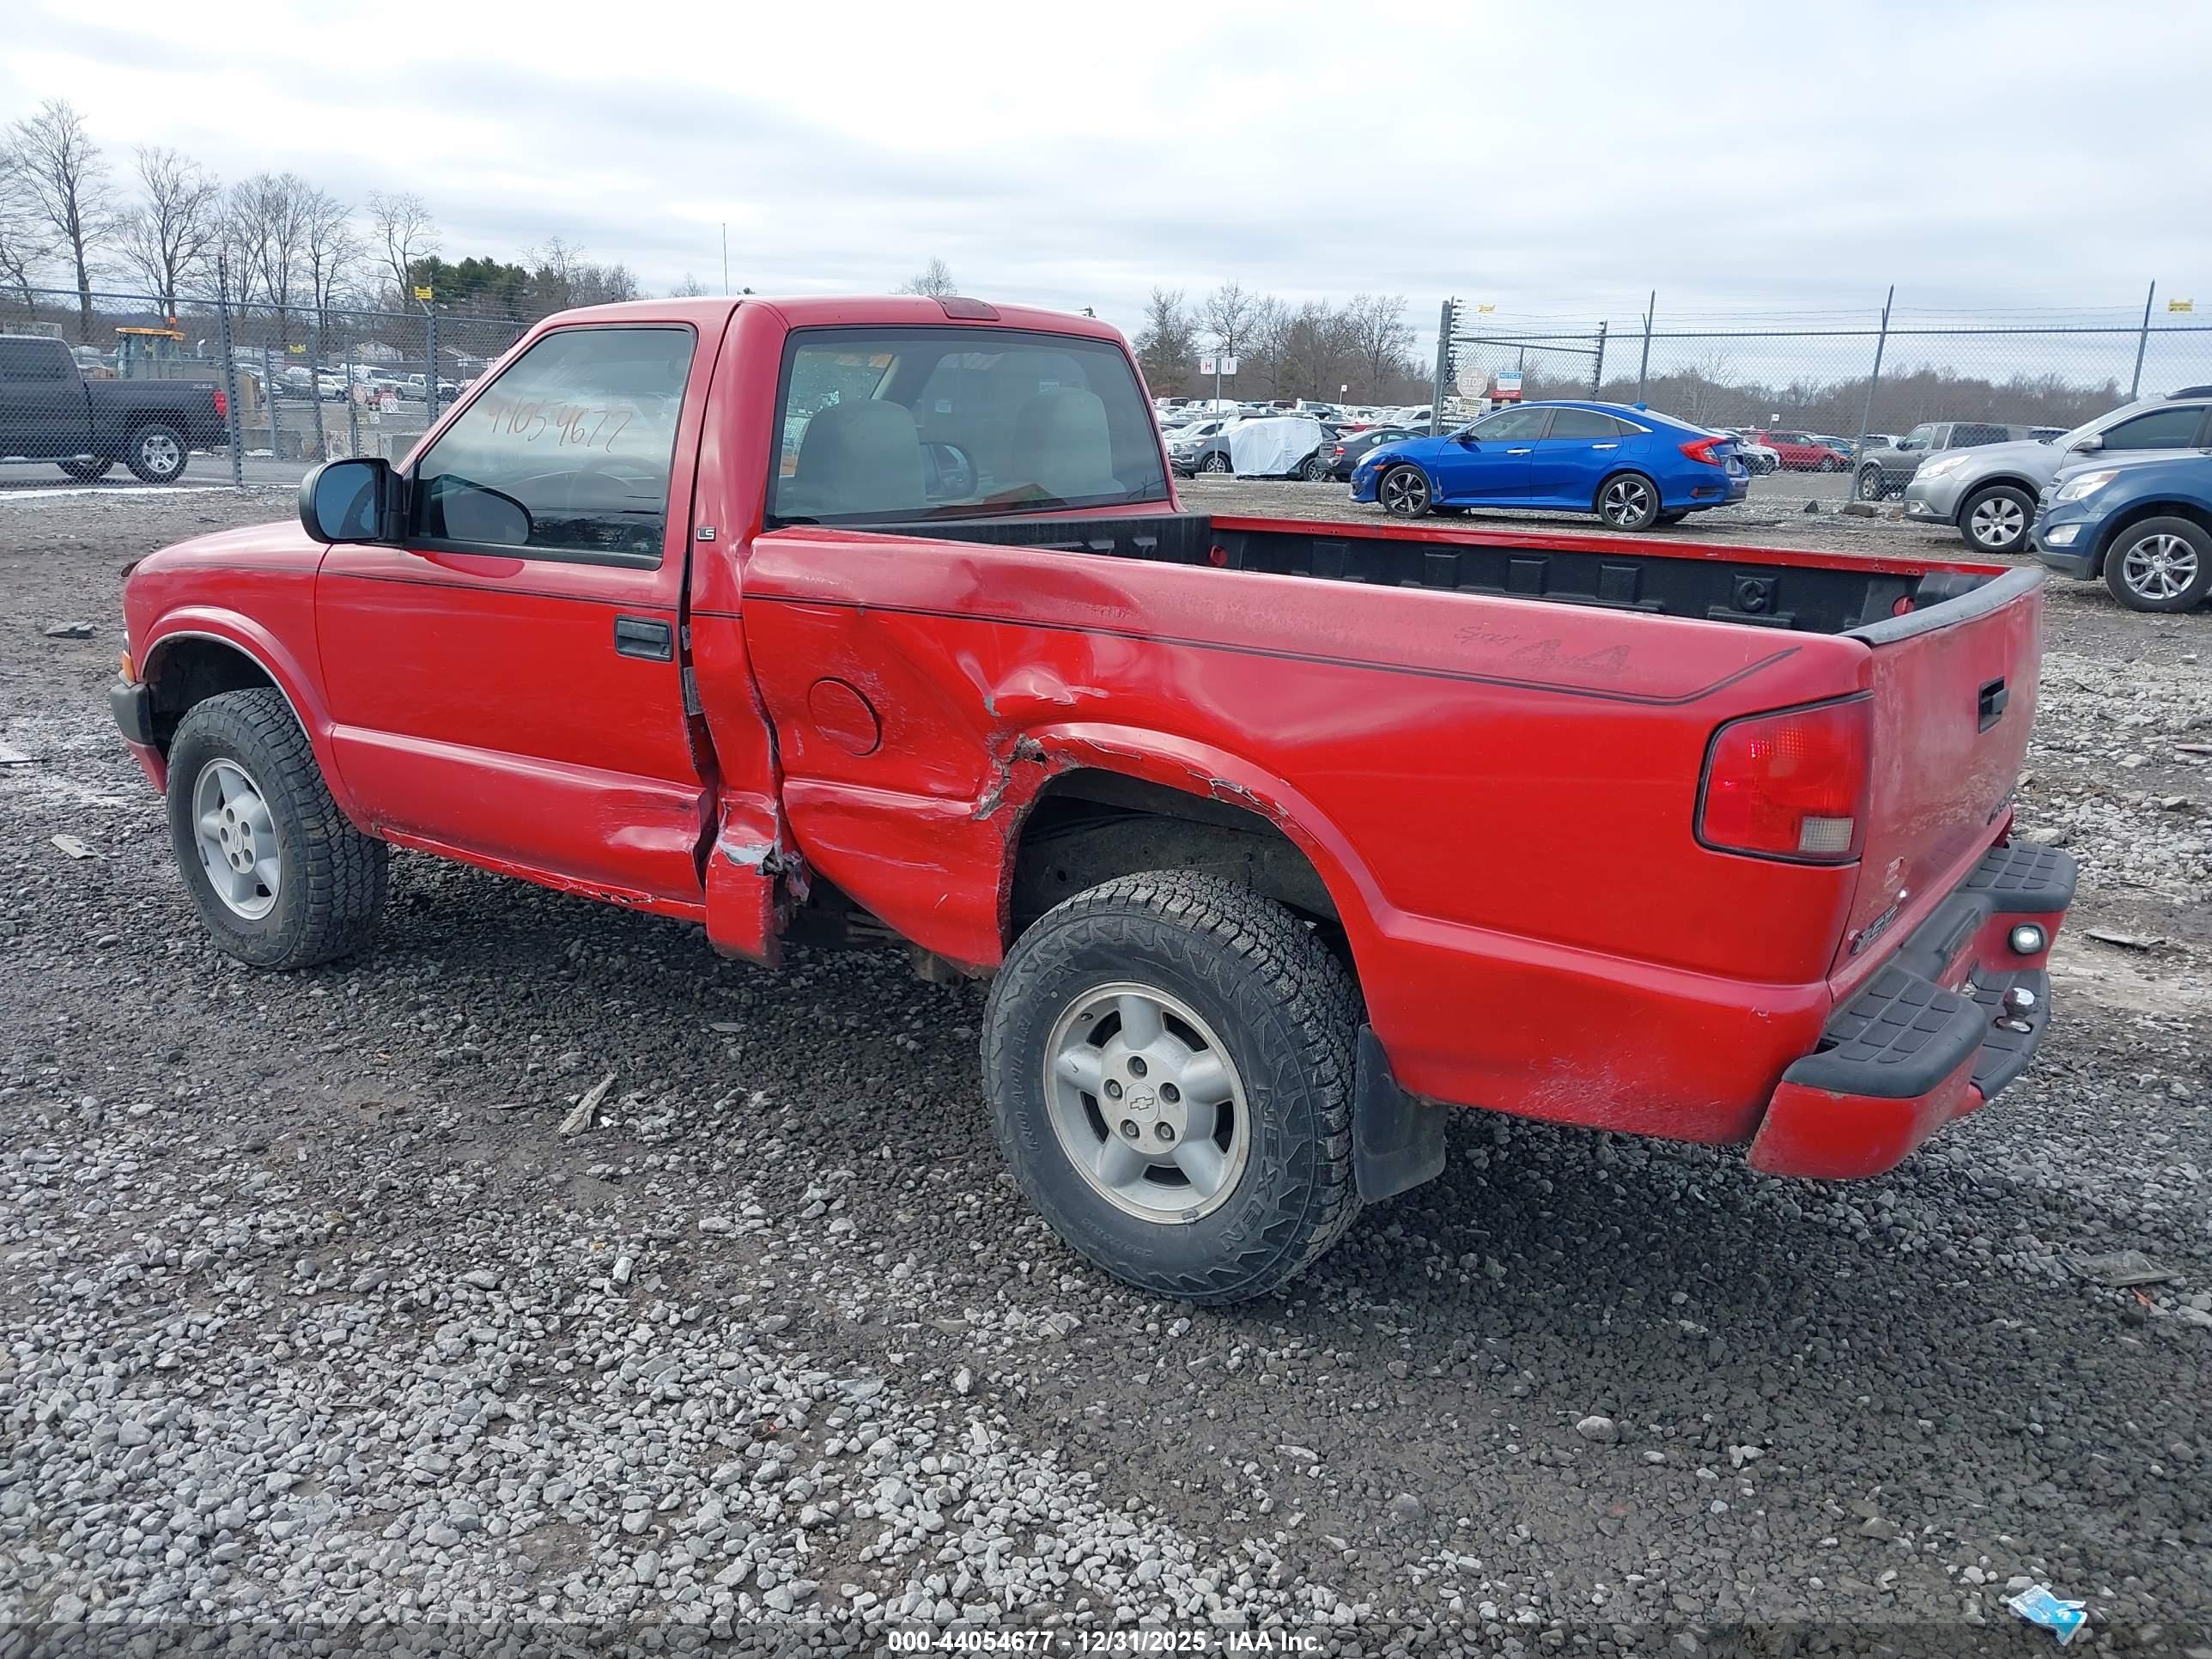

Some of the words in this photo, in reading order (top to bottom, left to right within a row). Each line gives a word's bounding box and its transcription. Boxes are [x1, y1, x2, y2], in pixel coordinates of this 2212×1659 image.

[1205, 362, 1212, 371] H
[1462, 377, 1484, 386] STOP
[1461, 398, 1483, 407] CAUTION
[1219, 1085, 1282, 1251] NEXEN
